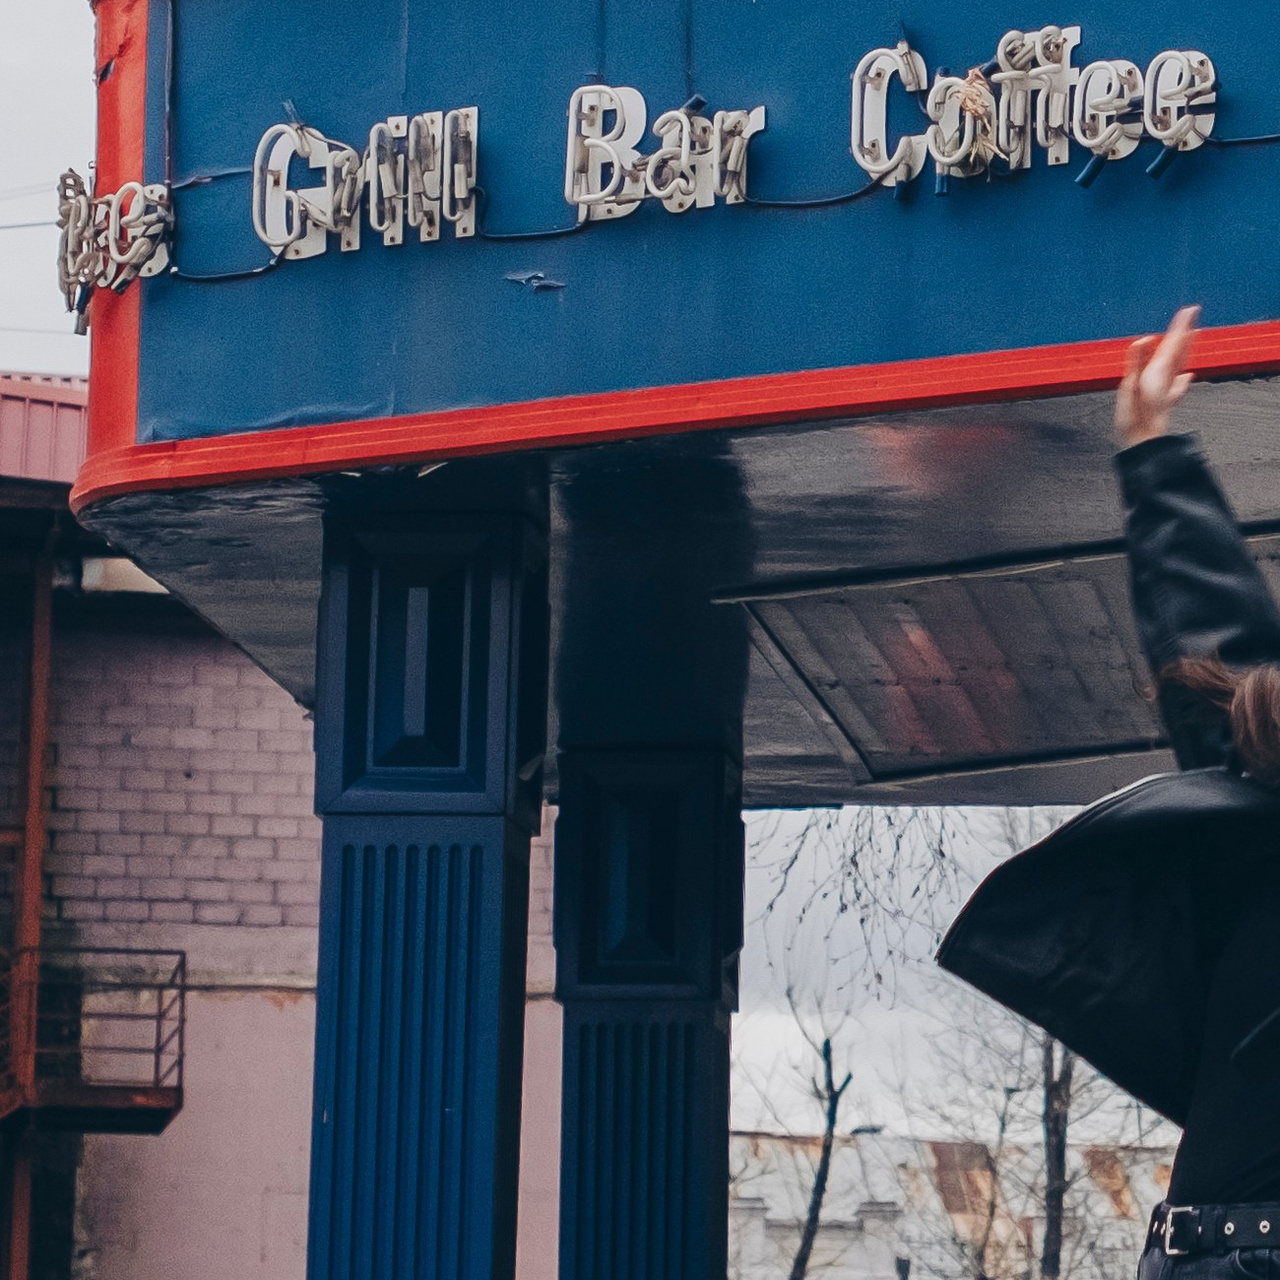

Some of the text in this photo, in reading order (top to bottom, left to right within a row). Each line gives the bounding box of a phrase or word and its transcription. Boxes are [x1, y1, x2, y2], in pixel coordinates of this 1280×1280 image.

[252, 106, 479, 260] Grill
[564, 85, 766, 220] Bar
[850, 26, 1218, 187] Coffee
